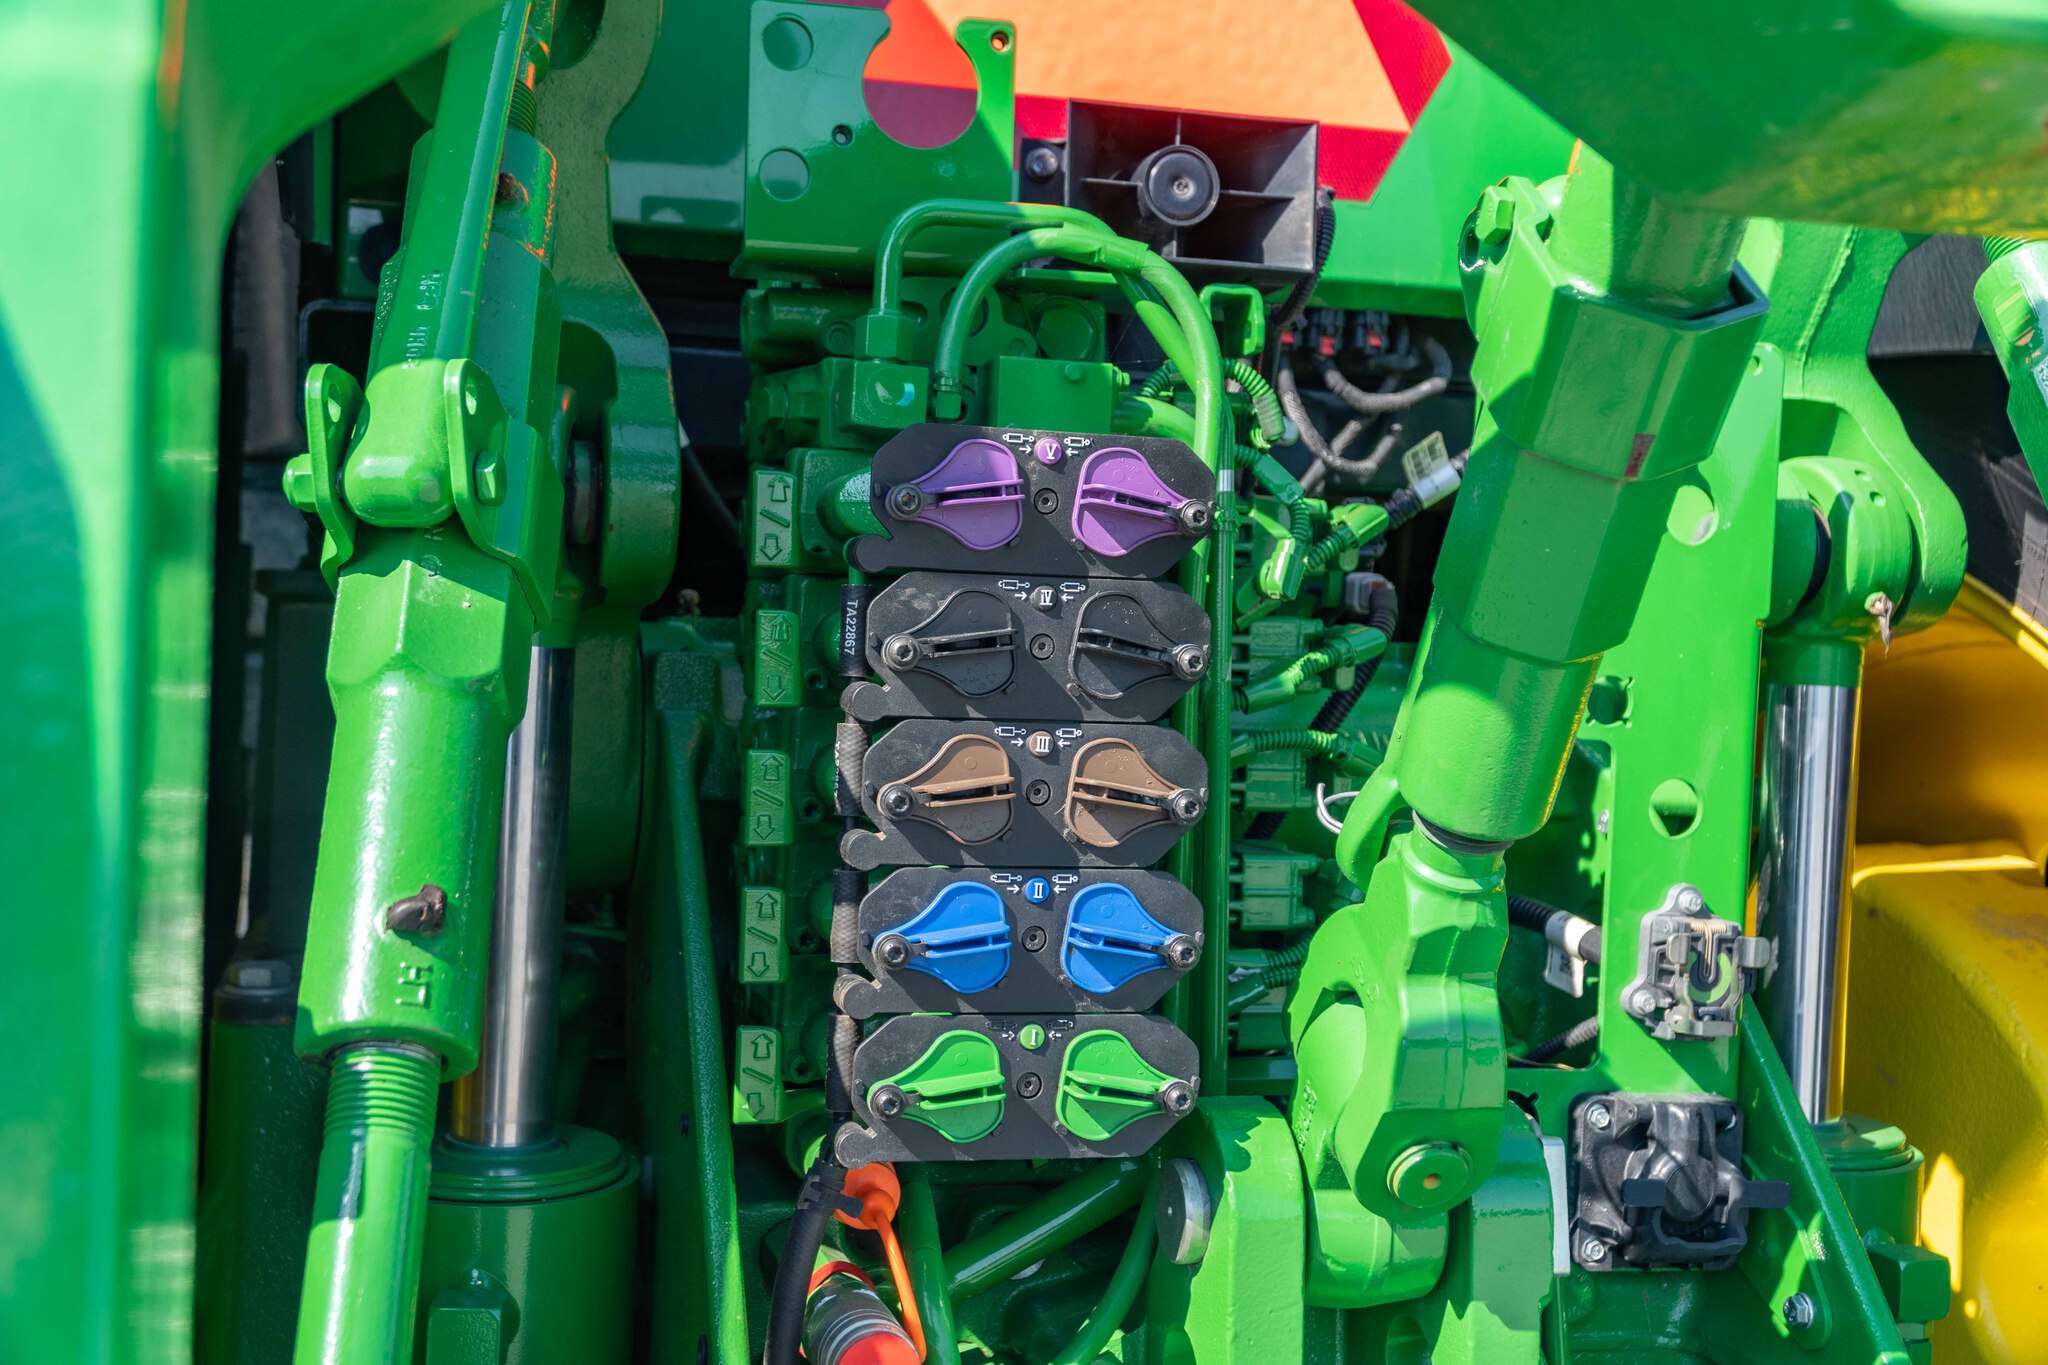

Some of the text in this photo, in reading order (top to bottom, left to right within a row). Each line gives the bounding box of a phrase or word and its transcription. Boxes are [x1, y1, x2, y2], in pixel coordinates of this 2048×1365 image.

[1045, 443, 1057, 459] V
[1040, 590, 1053, 605] IV
[844, 600, 858, 655] TA22867
[1035, 736, 1050, 752] III
[1033, 883, 1043, 898] II
[1030, 1029, 1037, 1045] I
